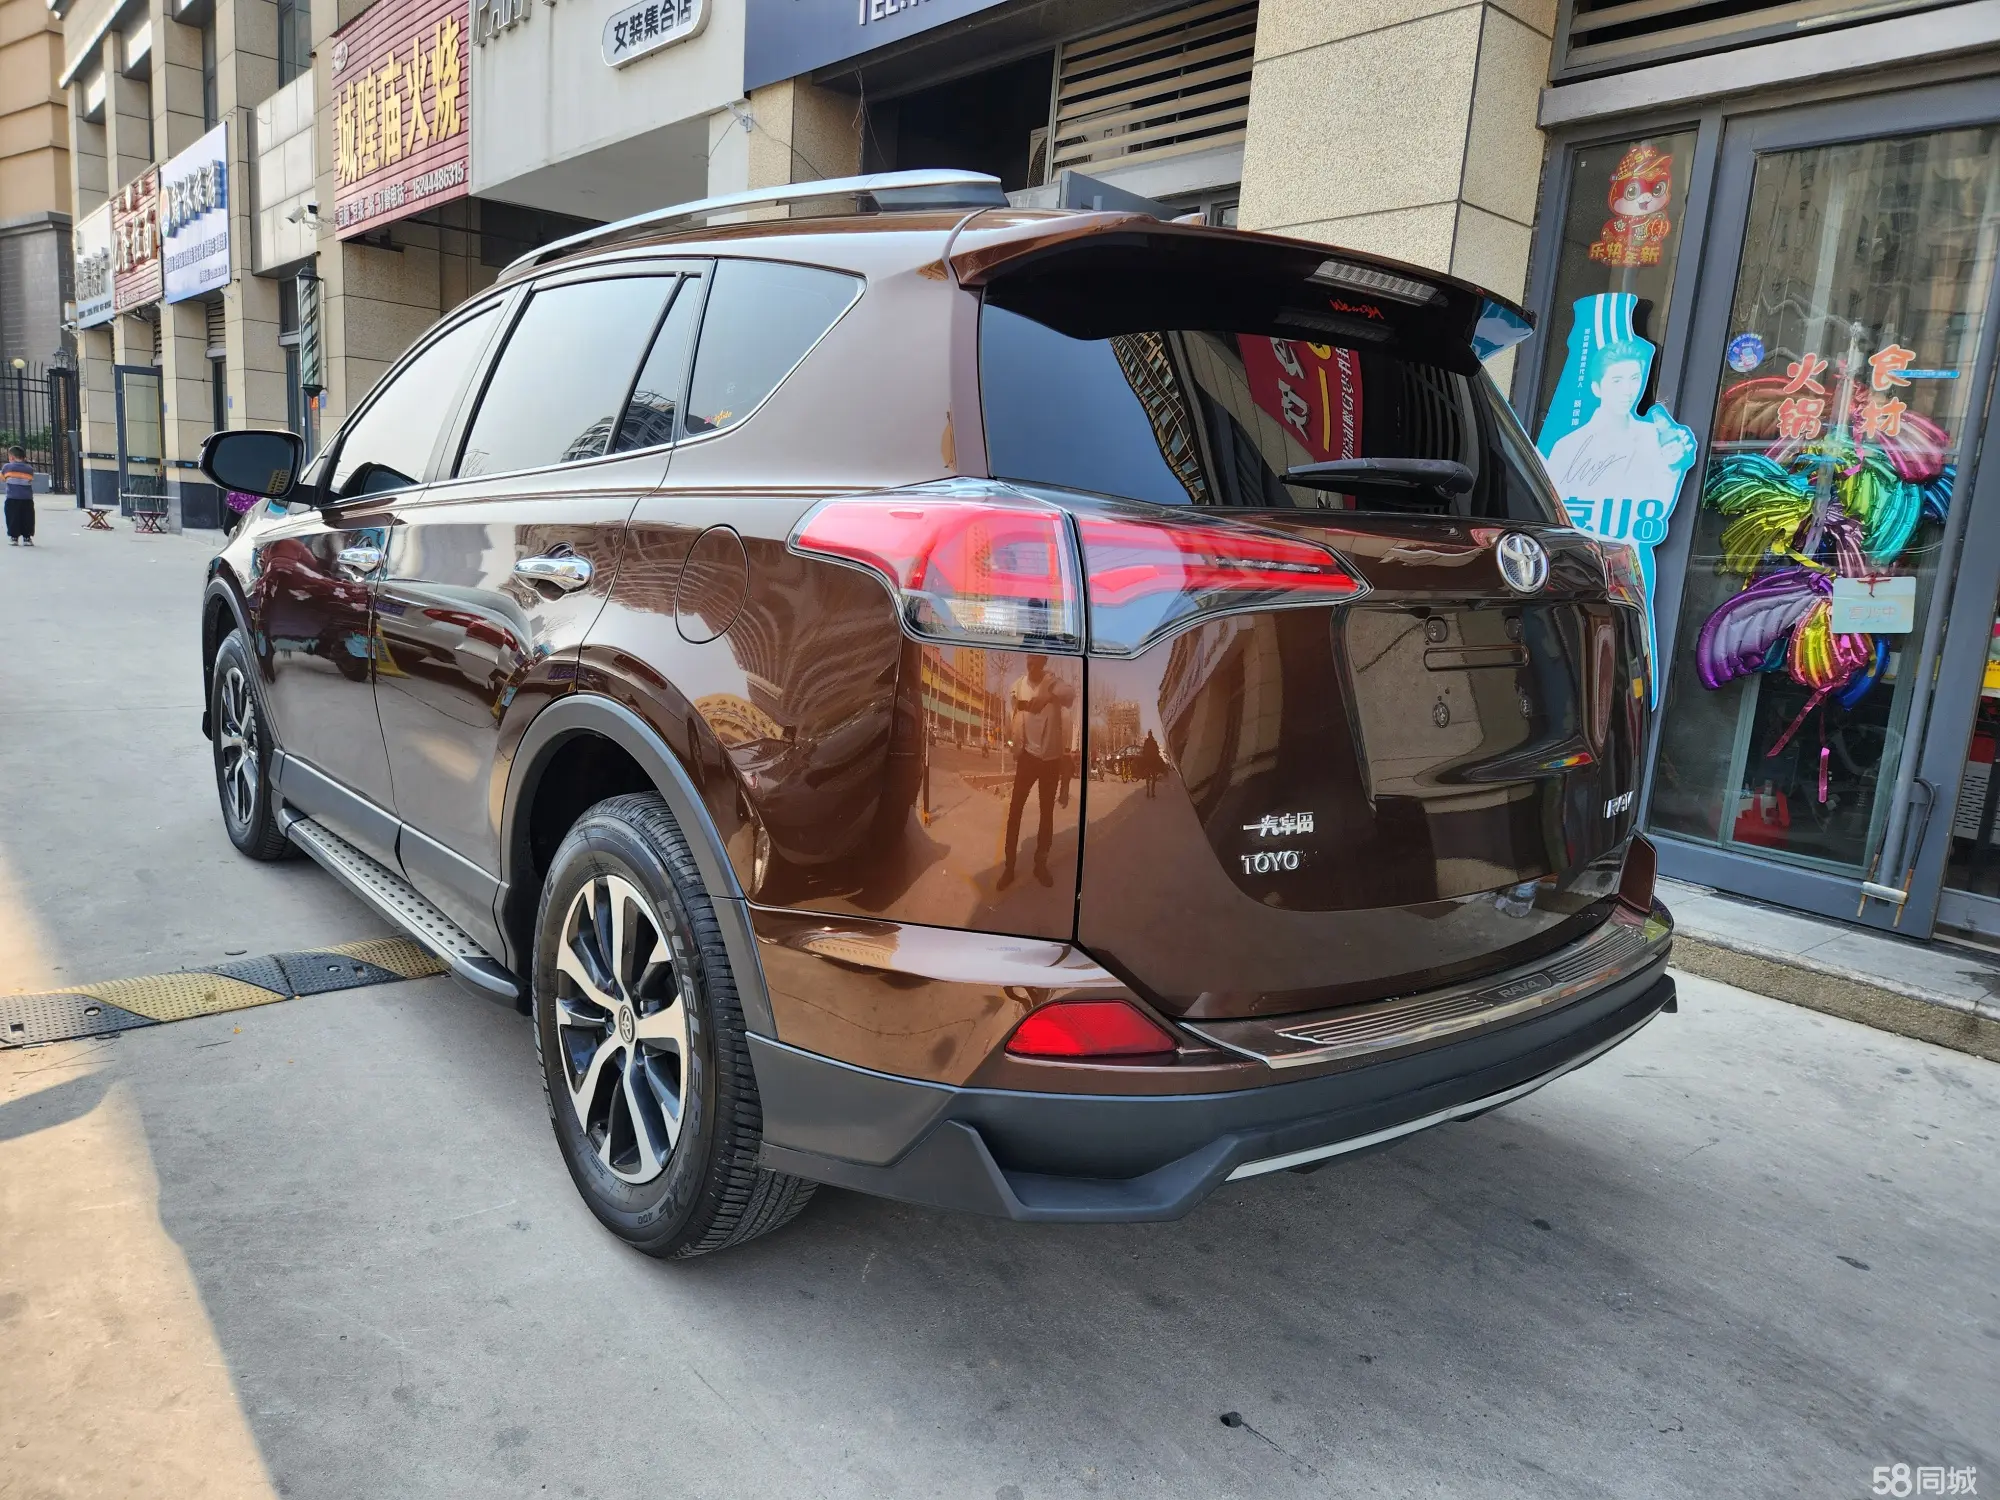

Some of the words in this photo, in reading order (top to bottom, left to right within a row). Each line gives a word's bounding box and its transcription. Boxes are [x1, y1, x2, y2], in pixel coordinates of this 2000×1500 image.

[613, 0, 693, 54] 女装集合店
[337, 15, 461, 186] 城隍庙火烧
[1777, 353, 1828, 440] 火锅
[1861, 344, 1916, 439] 食材
[657, 900, 703, 1136] DUELER
[1498, 980, 1541, 998] RAV4
